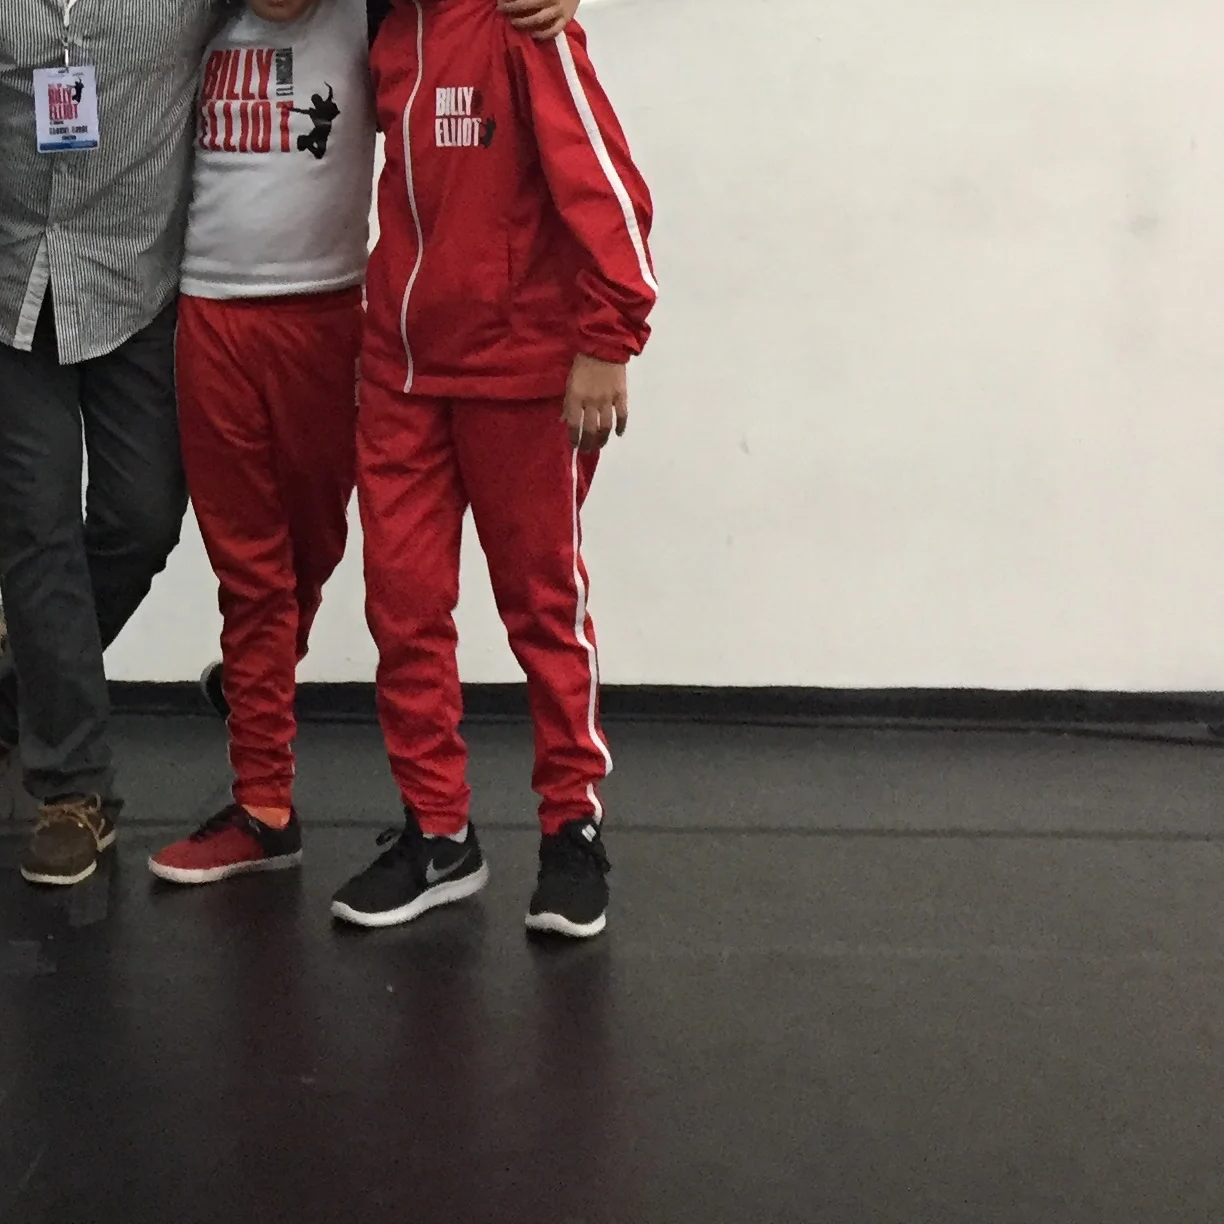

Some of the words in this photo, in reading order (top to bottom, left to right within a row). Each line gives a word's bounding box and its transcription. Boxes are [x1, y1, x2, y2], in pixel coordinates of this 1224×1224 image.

[201, 47, 276, 100] BILLY
[435, 86, 474, 116] BILLY
[198, 99, 294, 153] ELLIOT
[435, 117, 482, 147] ELLIOT
